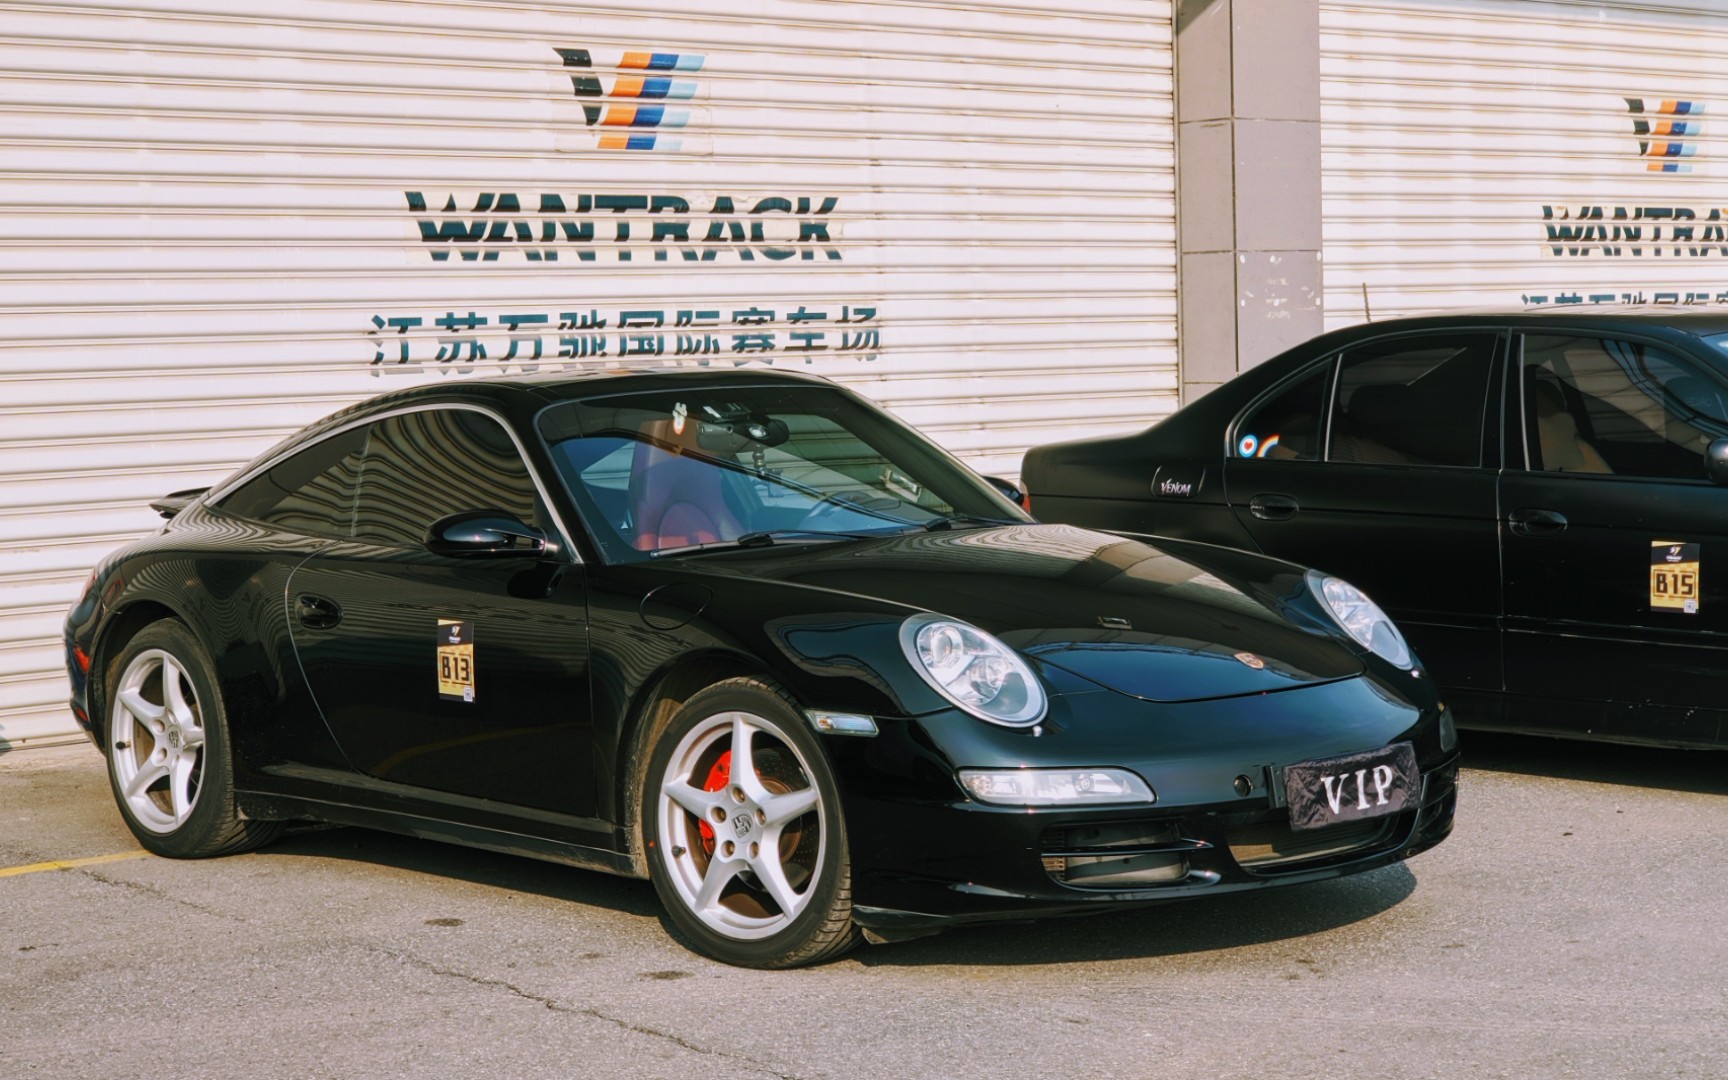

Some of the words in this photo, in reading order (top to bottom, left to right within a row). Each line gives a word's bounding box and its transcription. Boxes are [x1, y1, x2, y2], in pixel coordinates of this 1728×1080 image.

[405, 191, 842, 261] WANTRACK
[368, 306, 879, 377] 江苏万驰国际赛车场
[1161, 478, 1191, 497] VENOM
[1656, 573, 1693, 595] B15
[442, 656, 470, 681] B13
[1321, 764, 1393, 815] VIP
